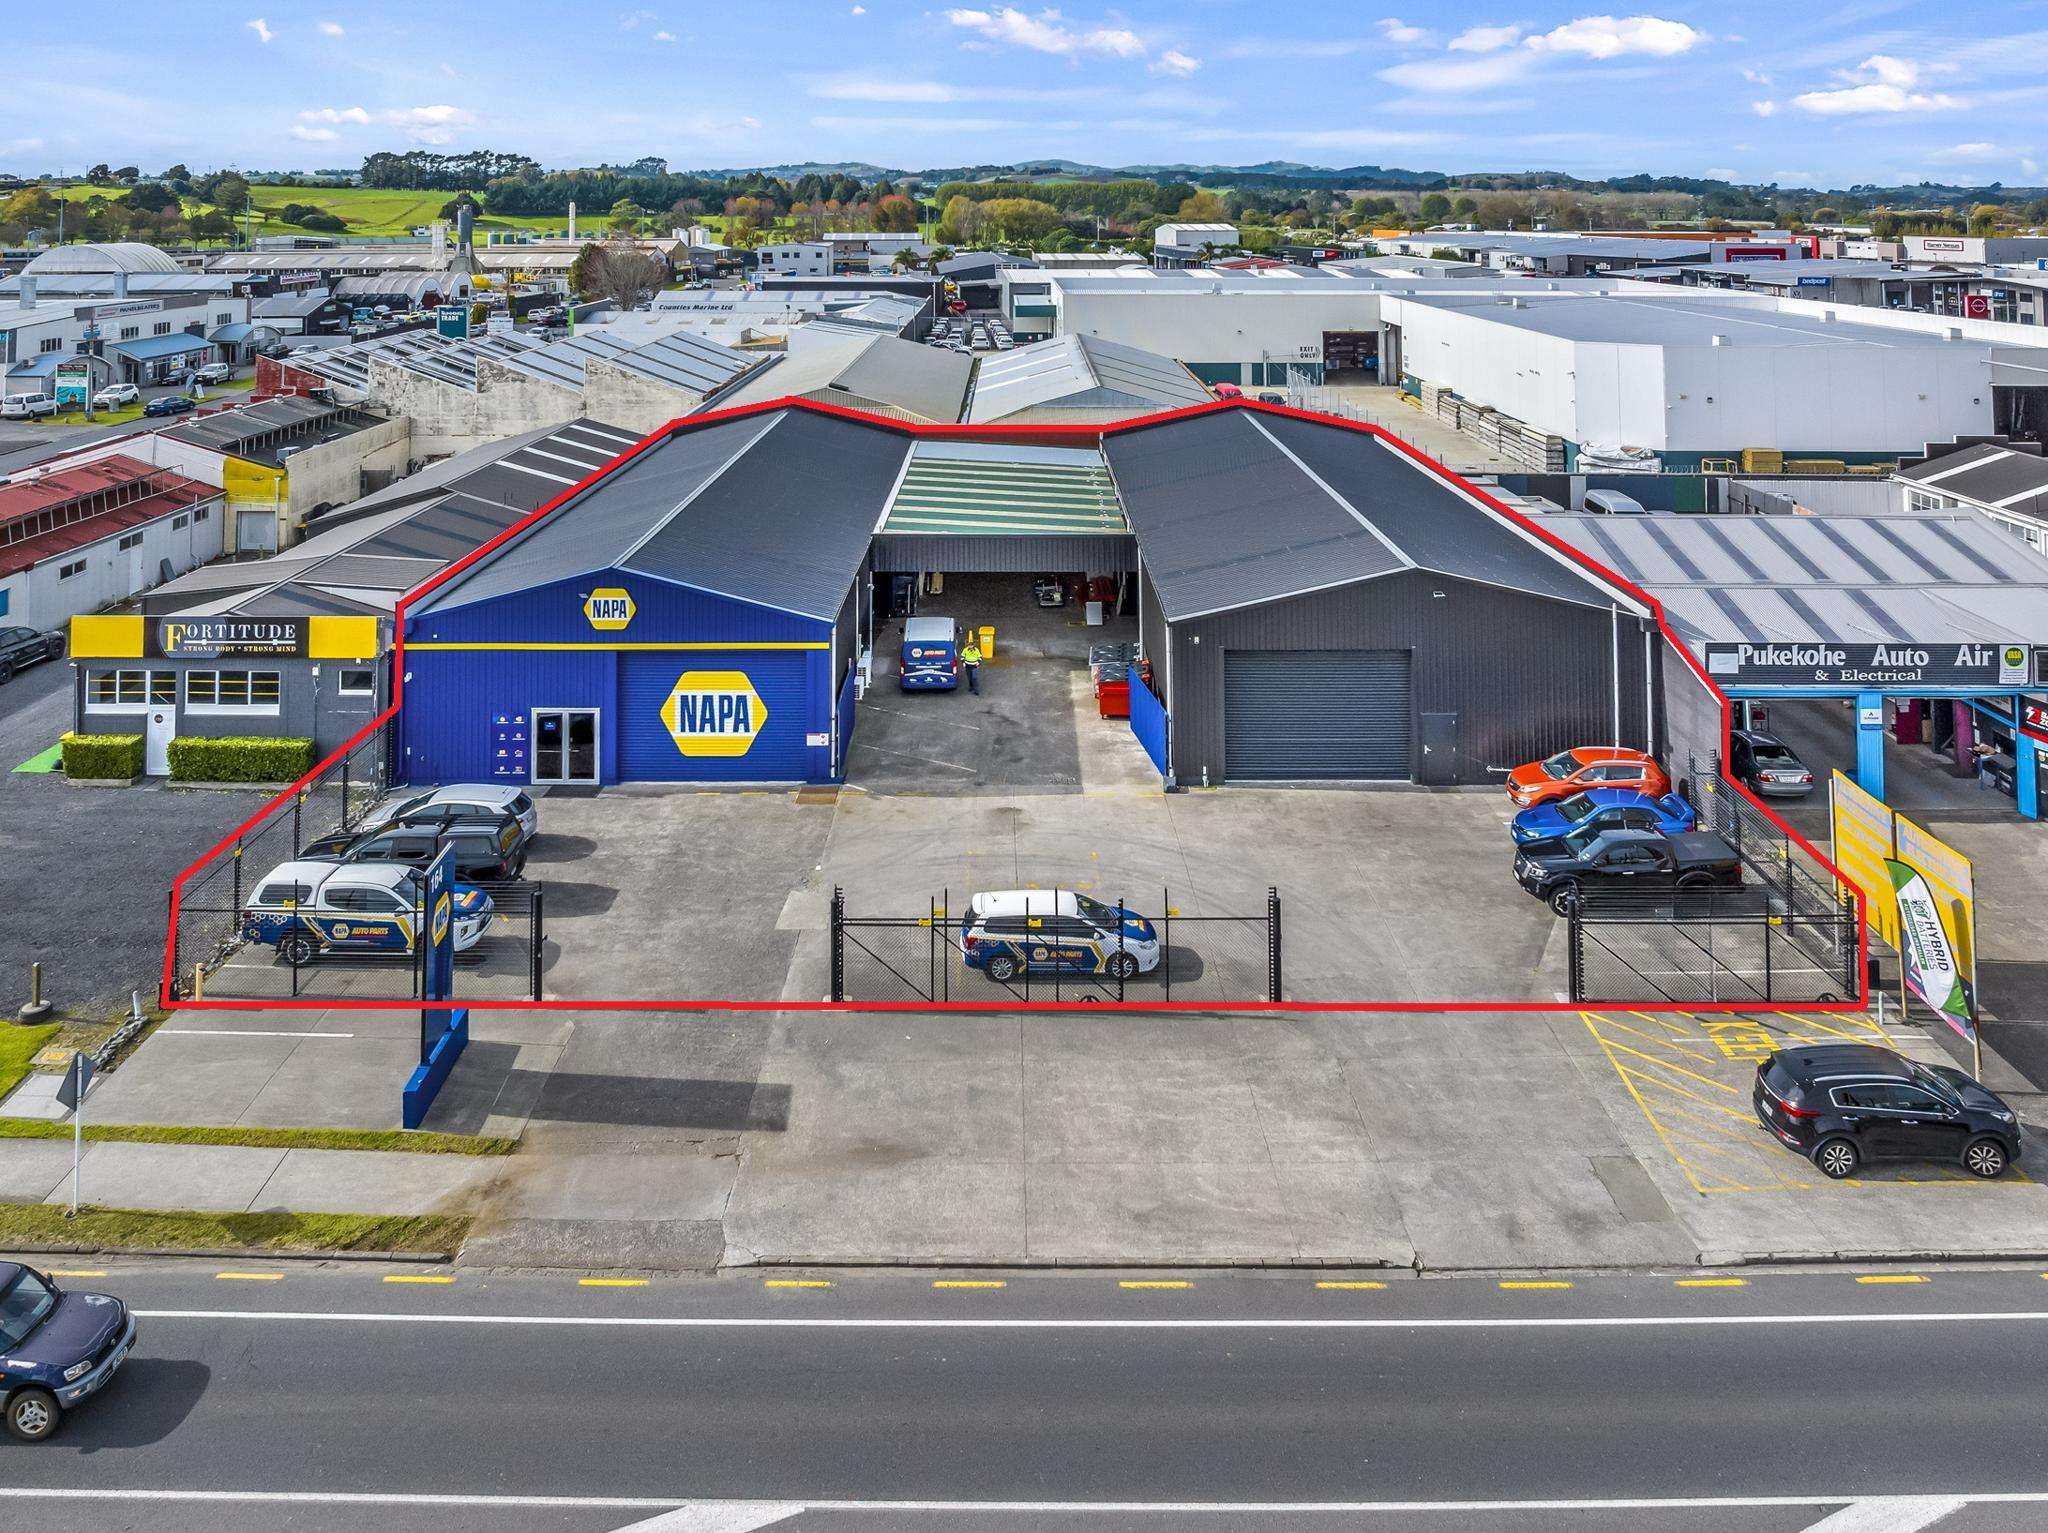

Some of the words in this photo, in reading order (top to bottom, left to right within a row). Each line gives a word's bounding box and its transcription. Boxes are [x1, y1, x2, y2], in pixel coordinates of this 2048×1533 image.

[592, 599, 627, 619] NAPA
[164, 623, 297, 652] FORTITUDE
[1738, 643, 1846, 667] Pukekohe
[1870, 643, 1930, 667] Auto
[1953, 643, 1994, 667] Air
[1814, 669, 1830, 682] &
[1839, 669, 1923, 682] Electrical
[680, 694, 751, 733] NAPA
[431, 864, 444, 894] 164
[351, 927, 369, 935] AUTO
[369, 927, 389, 935] PARTS
[1915, 919, 1938, 970] BATTERIES
[1924, 919, 1950, 972] HYBRID
[1700, 1021, 1781, 1065] KEE
